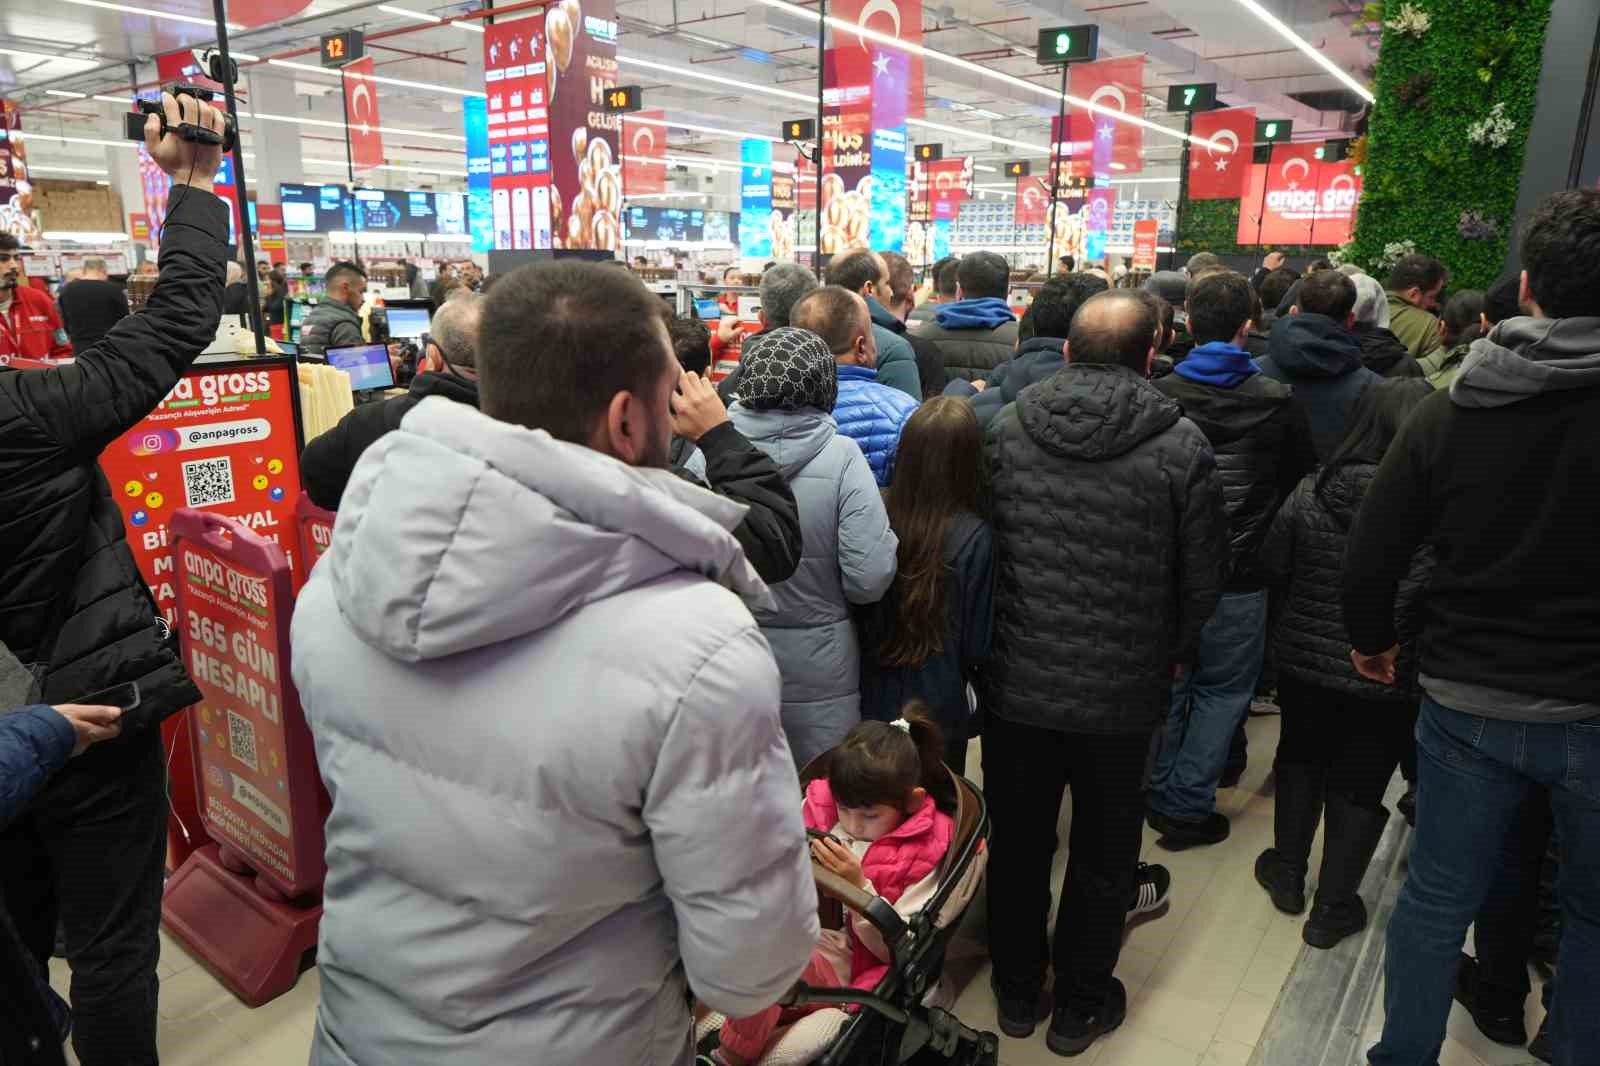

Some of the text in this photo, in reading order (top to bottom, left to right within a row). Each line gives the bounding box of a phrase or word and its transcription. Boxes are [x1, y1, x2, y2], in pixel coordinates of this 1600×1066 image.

[327, 38, 344, 57] 12
[1056, 33, 1070, 54] 9
[609, 91, 627, 107] 10
[1184, 91, 1197, 106] 7
[1012, 163, 1021, 174] 4
[1265, 188, 1361, 212] anpa gro
[199, 371, 270, 406] gross
[189, 427, 259, 443] @anpagross
[312, 523, 333, 548] an
[184, 549, 225, 587] anpa
[227, 567, 268, 608] gross
[188, 610, 276, 685] 365 GÜN
[191, 647, 279, 725] HESAPLI
